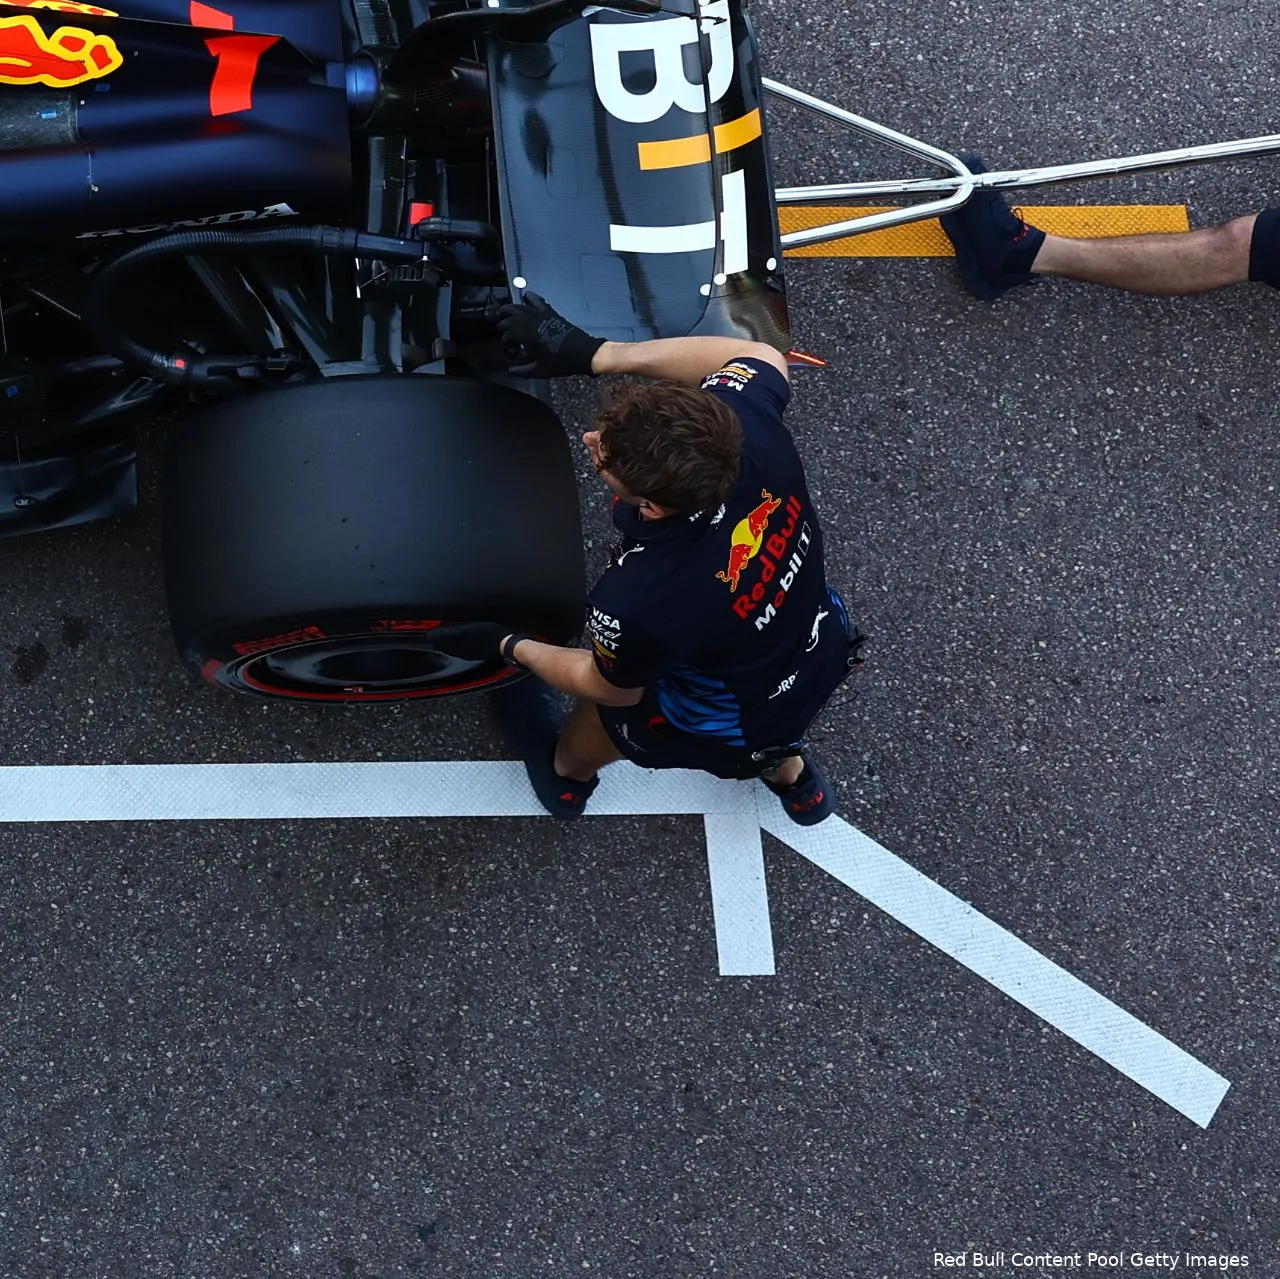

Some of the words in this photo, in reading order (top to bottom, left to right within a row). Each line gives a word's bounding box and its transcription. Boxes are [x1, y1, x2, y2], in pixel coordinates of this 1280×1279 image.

[731, 556, 777, 620] Red
[770, 495, 802, 554] Bull
[754, 552, 803, 632] Mobil
[592, 606, 621, 631] VISA
